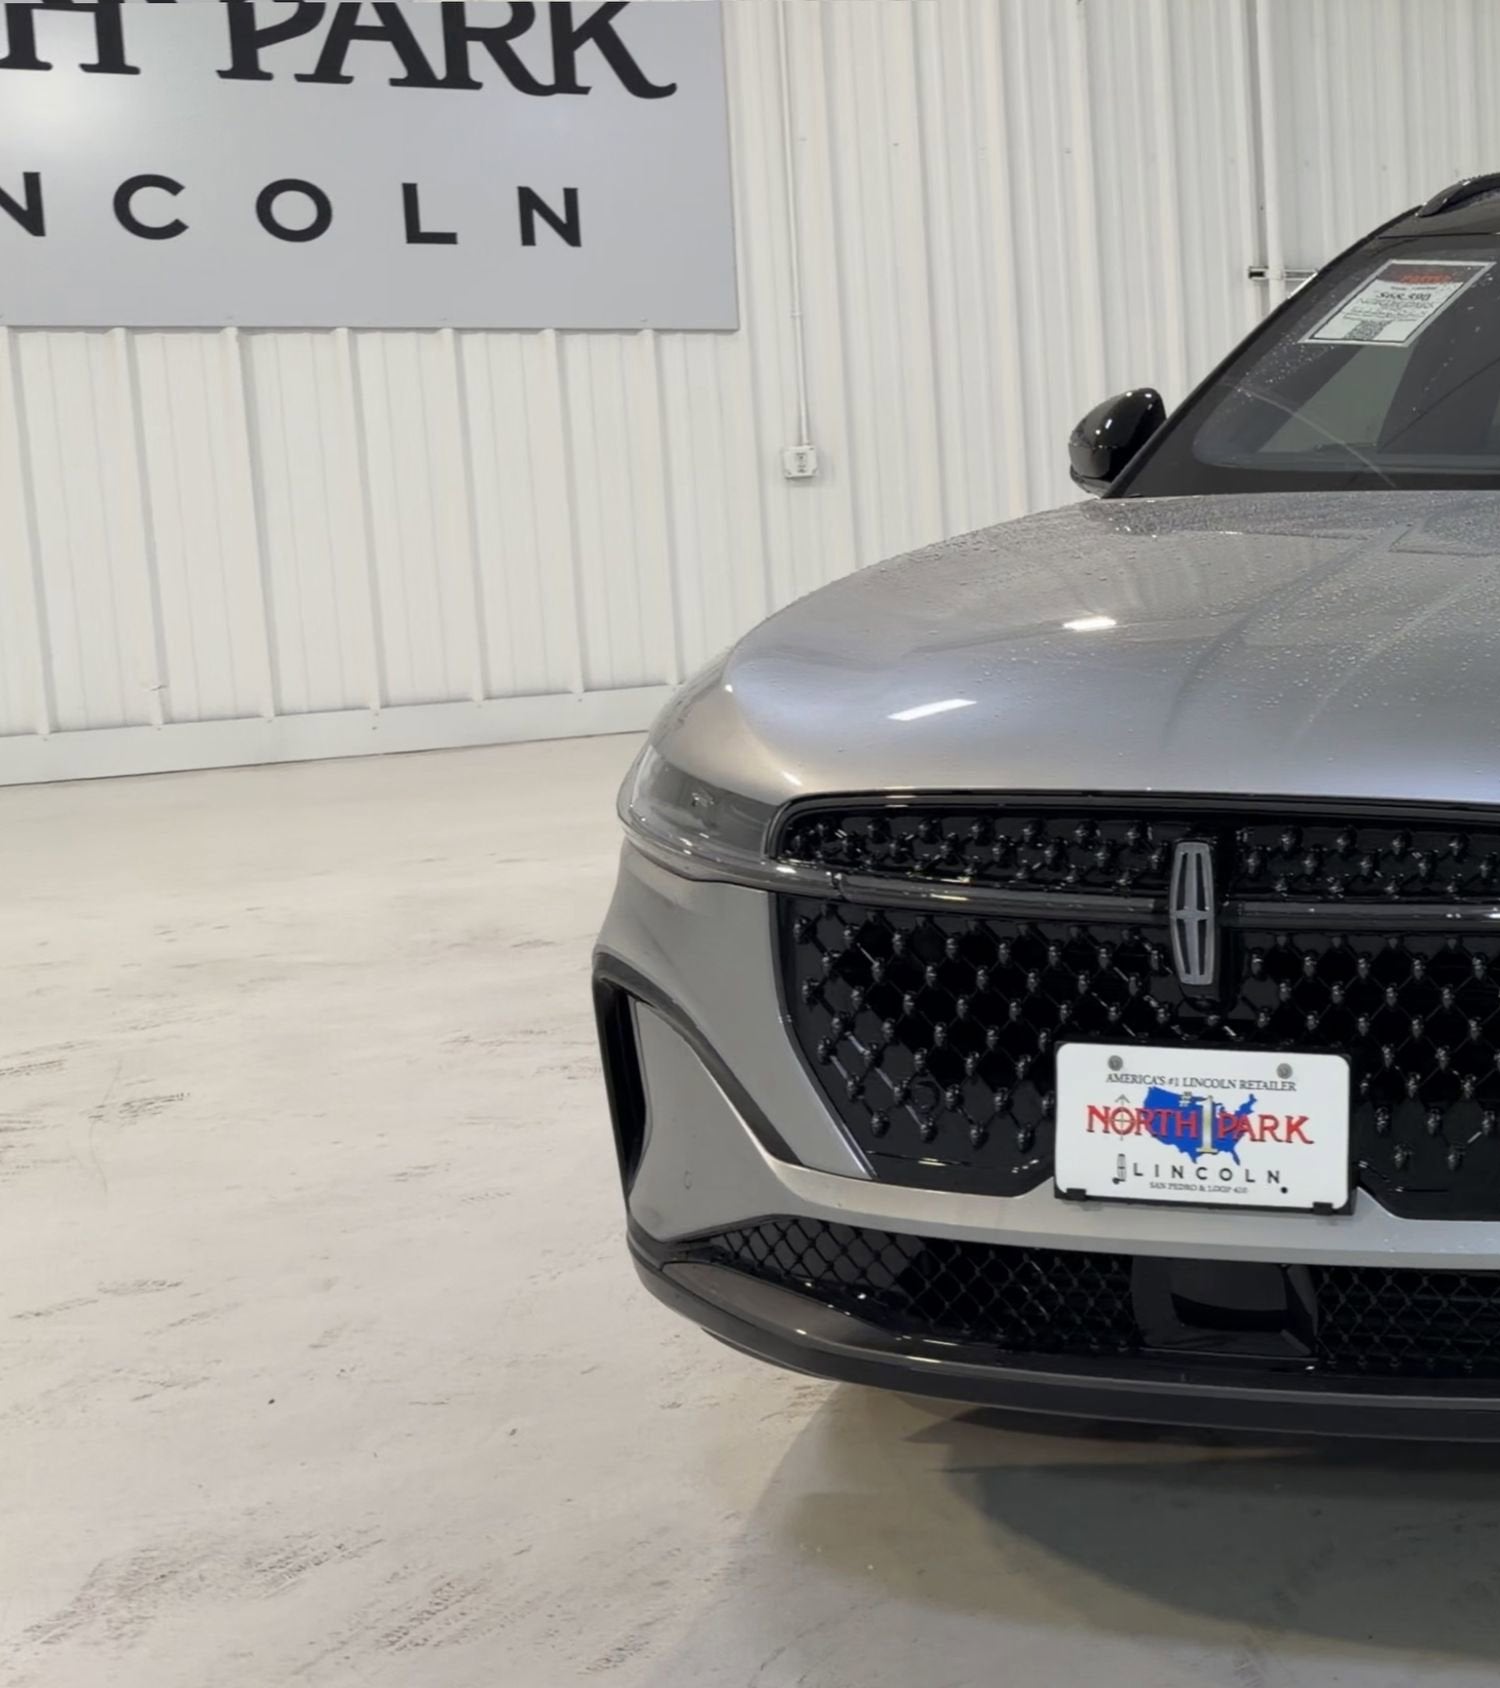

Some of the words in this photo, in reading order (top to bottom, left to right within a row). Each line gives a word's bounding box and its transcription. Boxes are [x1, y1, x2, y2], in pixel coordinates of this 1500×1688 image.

[216, 0, 678, 99] PARK
[1106, 1073, 1166, 1086] AMERICA'S
[1168, 1077, 1180, 1088] #1
[1183, 1077, 1237, 1089] LINCOLN
[1239, 1080, 1297, 1092] RETAILER
[1087, 1105, 1199, 1139] NORTH
[1217, 1110, 1315, 1145] PARK
[1133, 1162, 1281, 1184] LINCOLN
